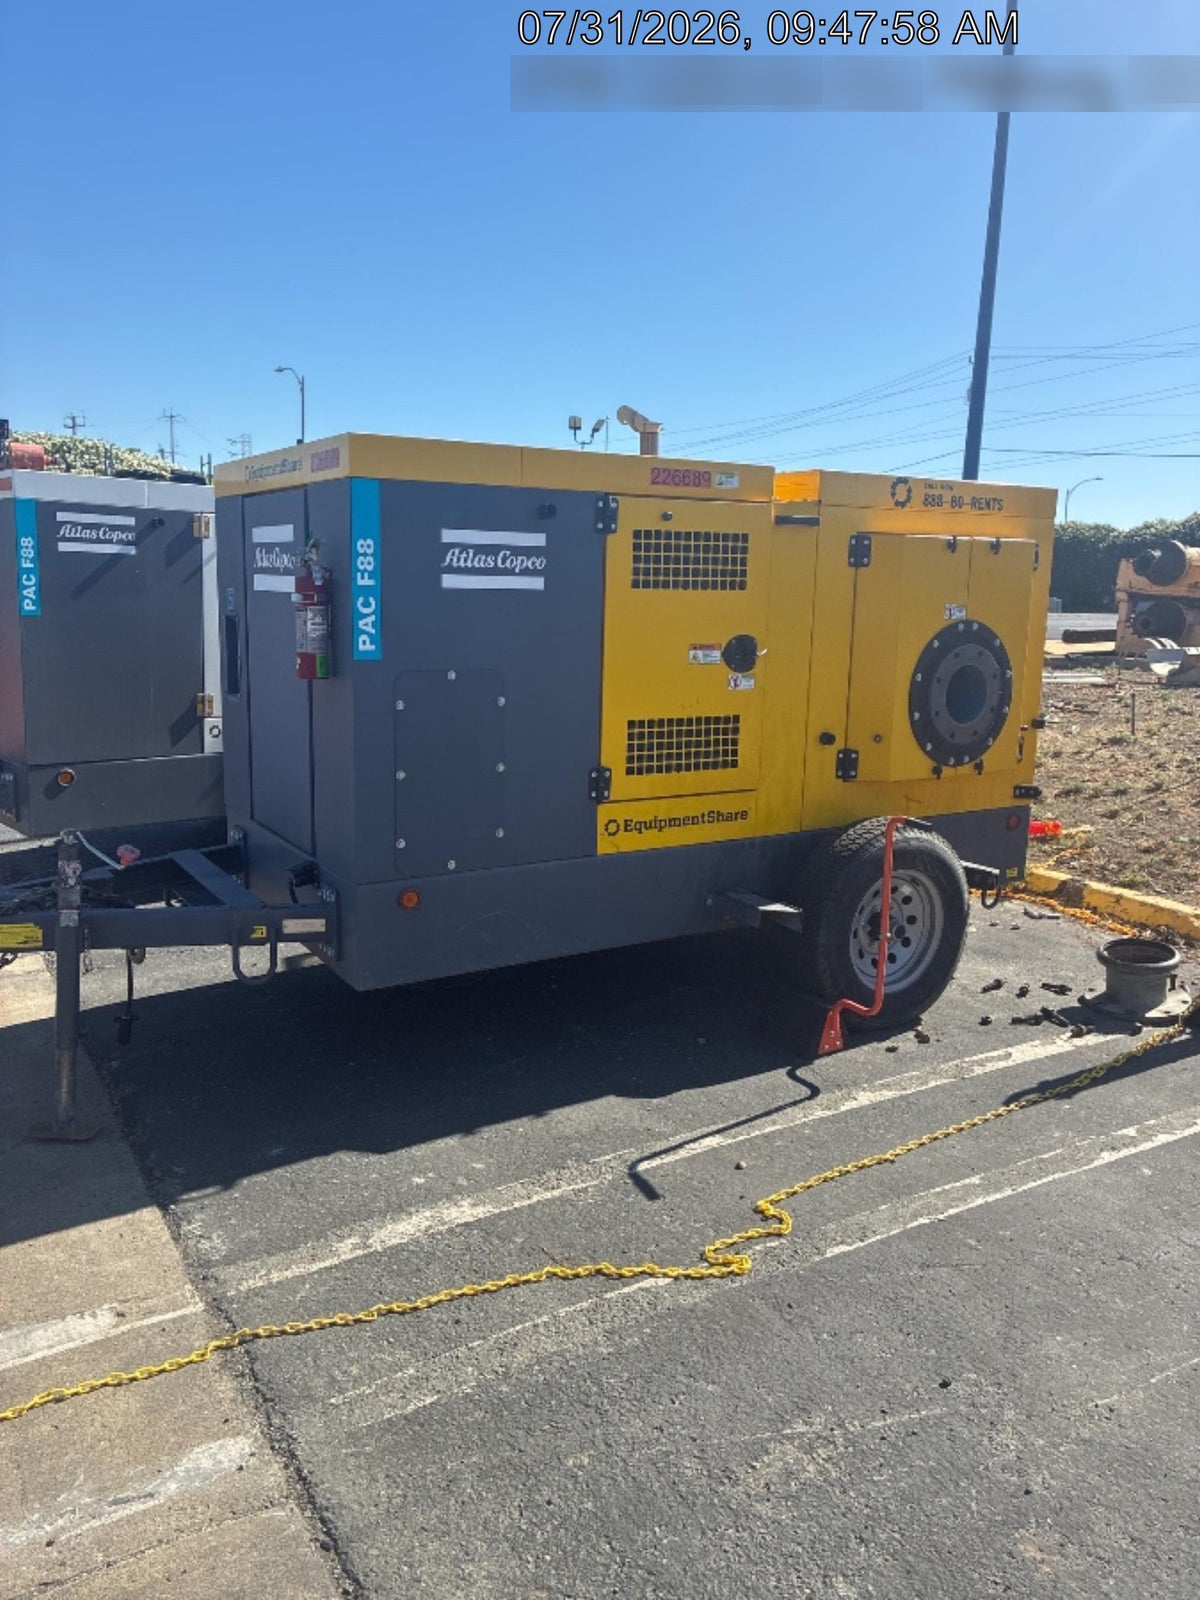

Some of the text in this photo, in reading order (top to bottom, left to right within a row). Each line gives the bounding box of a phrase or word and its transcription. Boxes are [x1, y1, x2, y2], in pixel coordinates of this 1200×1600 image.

[651, 467, 711, 487] 226689
[56, 523, 98, 540] Atlas
[440, 547, 547, 573] Atlas Copco
[20, 536, 37, 611] PAC F88
[356, 538, 377, 652] PAC F88
[622, 809, 749, 834] EquipmentShare
